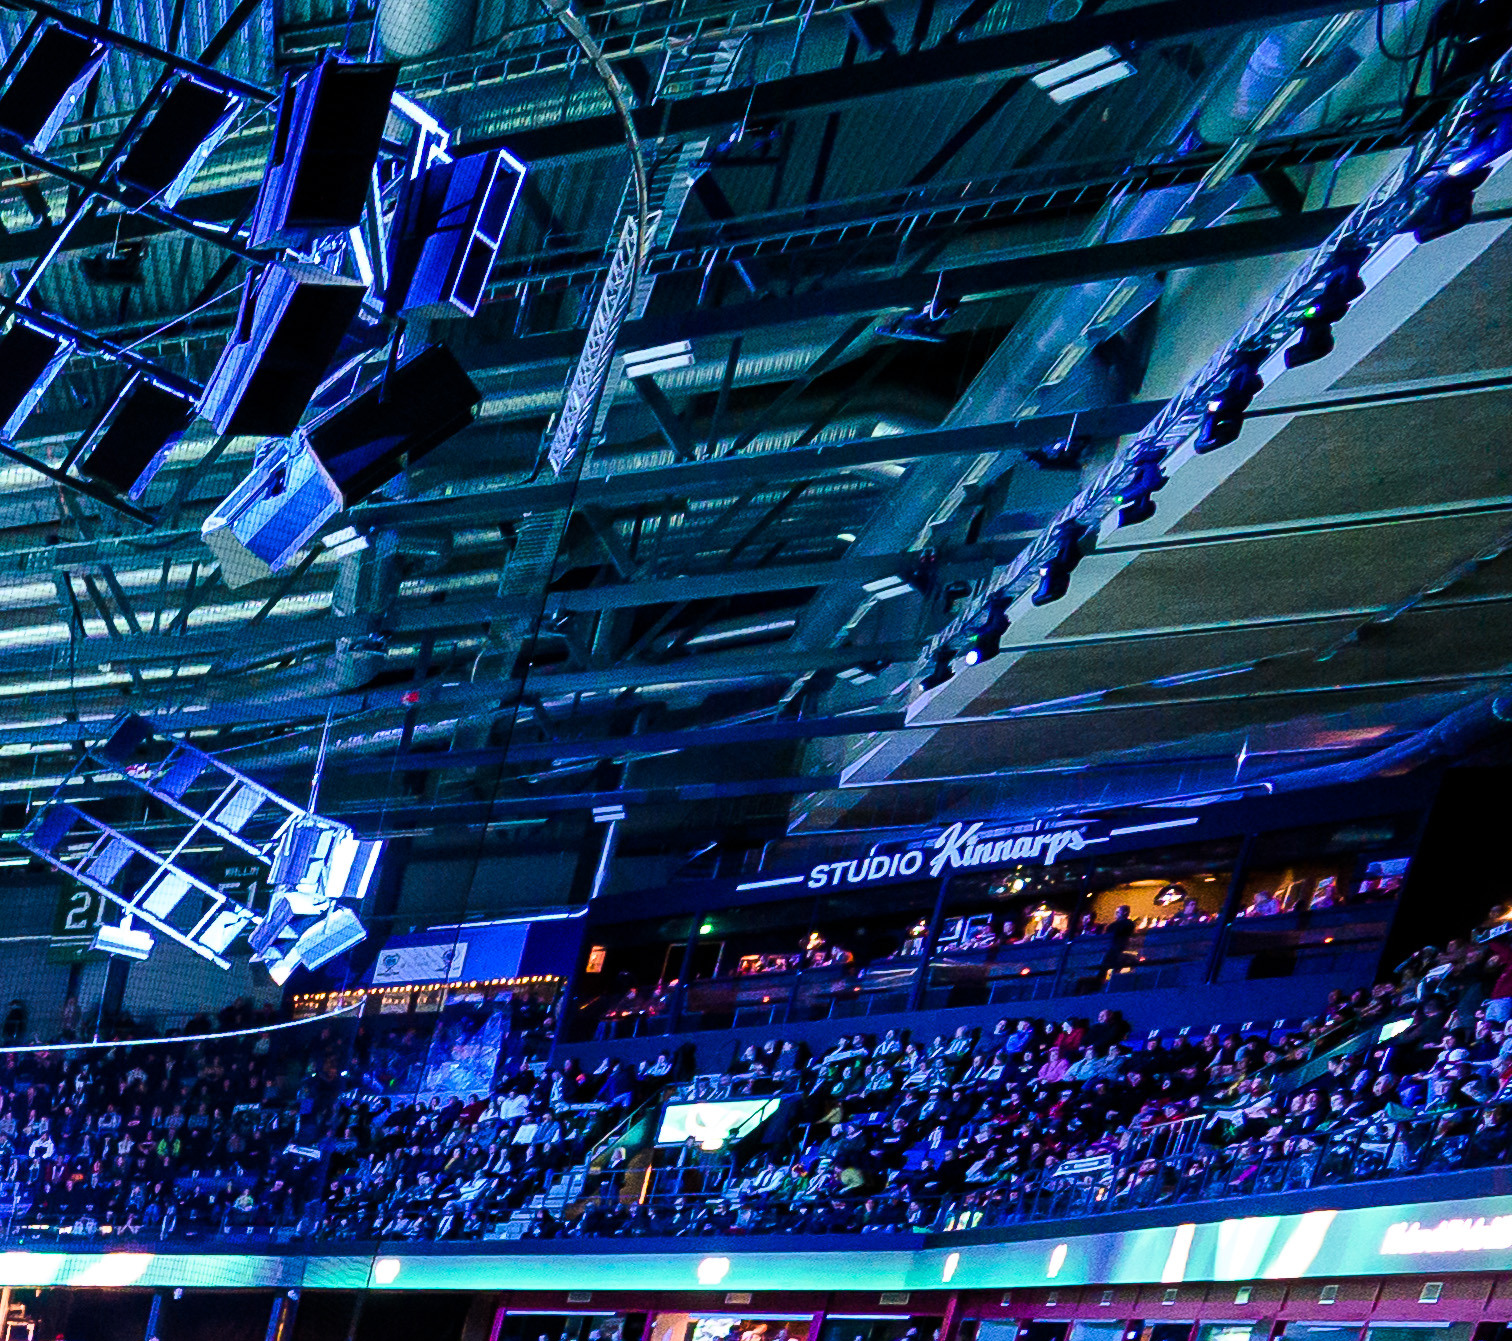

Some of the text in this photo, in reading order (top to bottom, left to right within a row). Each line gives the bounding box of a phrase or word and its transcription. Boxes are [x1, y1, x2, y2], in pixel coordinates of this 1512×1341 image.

[807, 821, 1088, 888] STUDIO Kinnarps
[64, 891, 106, 930] 21
